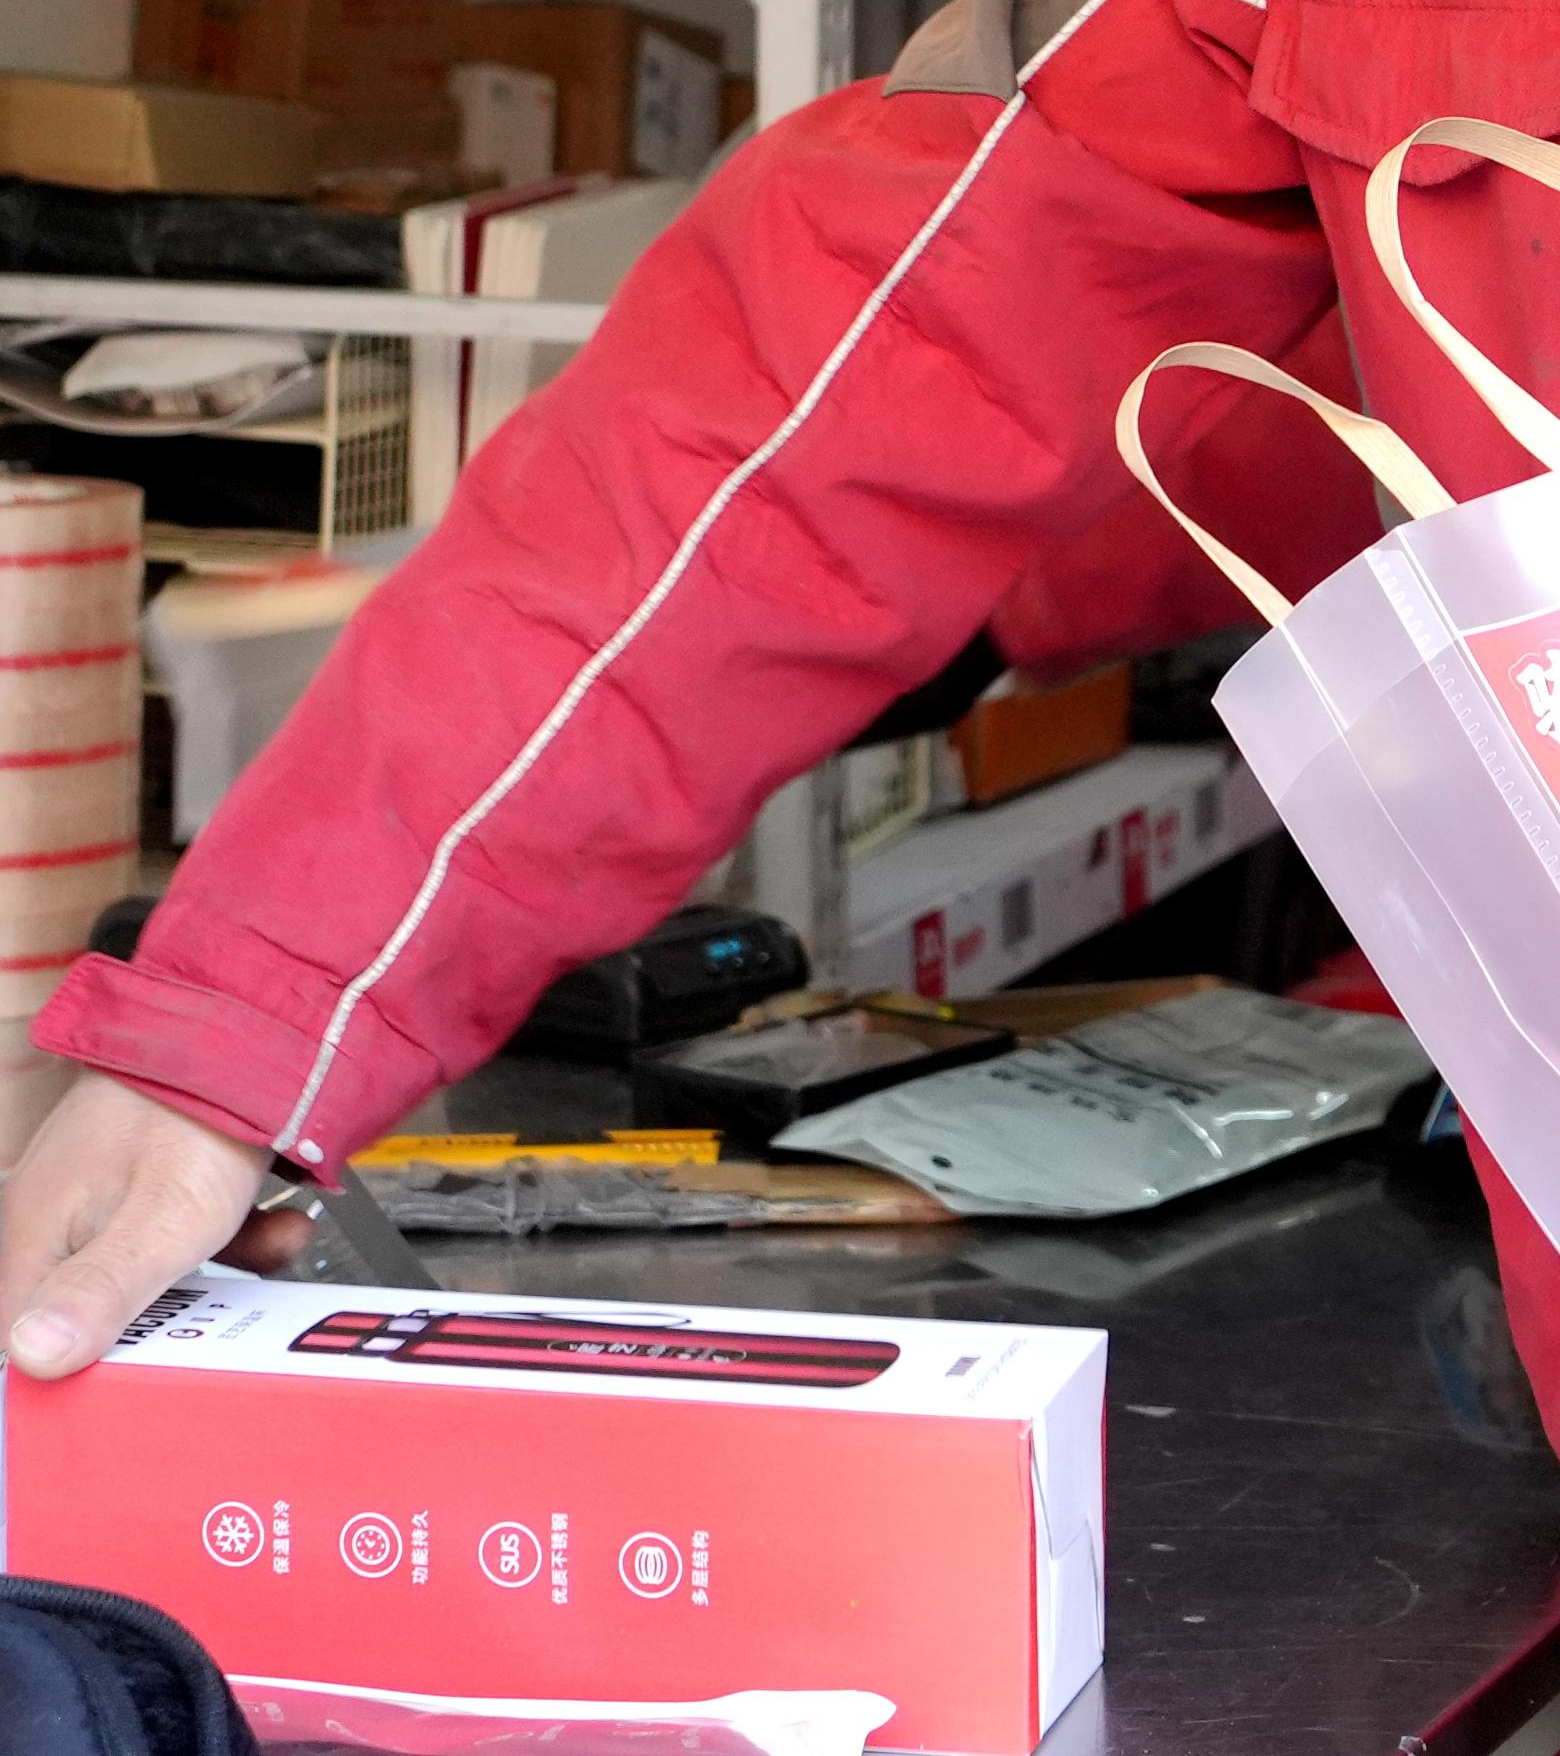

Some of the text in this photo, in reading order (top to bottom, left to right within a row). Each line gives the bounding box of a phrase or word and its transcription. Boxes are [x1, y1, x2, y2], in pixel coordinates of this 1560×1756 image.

[271, 1499, 292, 1575] 保温保冷
[410, 1509, 430, 1585] 功能持久
[499, 1533, 521, 1574] SUS
[551, 1512, 569, 1606] 优质不锈钢
[690, 1529, 711, 1606] 多层结构
